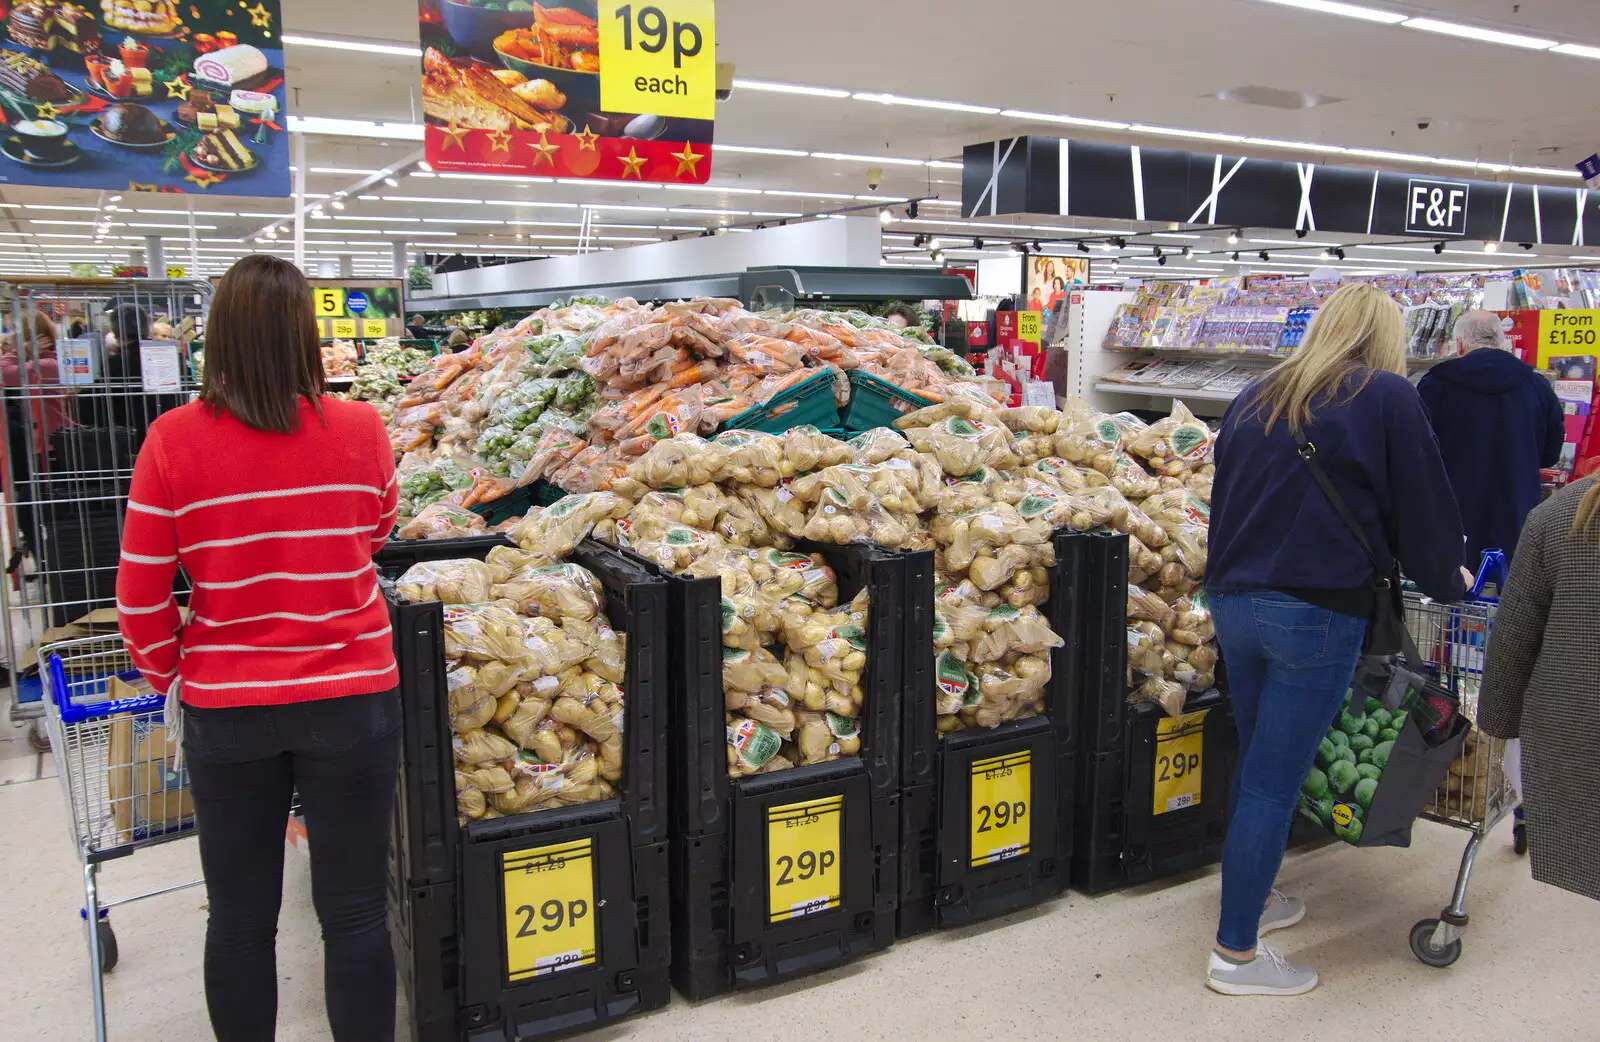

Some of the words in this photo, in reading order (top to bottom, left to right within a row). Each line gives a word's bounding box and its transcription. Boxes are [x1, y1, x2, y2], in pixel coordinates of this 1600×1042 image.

[615, 4, 703, 68] 19p
[634, 74, 688, 96] each
[1410, 186, 1464, 227] F&F
[1021, 324, 1038, 334] £1.50
[1022, 313, 1036, 322] From
[1553, 313, 1593, 326] From
[1549, 329, 1596, 345] £1.50
[1158, 752, 1199, 782] 29p
[1176, 796, 1191, 807] 29p
[976, 801, 1026, 834] 29p
[775, 849, 835, 886] 29p
[514, 899, 588, 939] 29p
